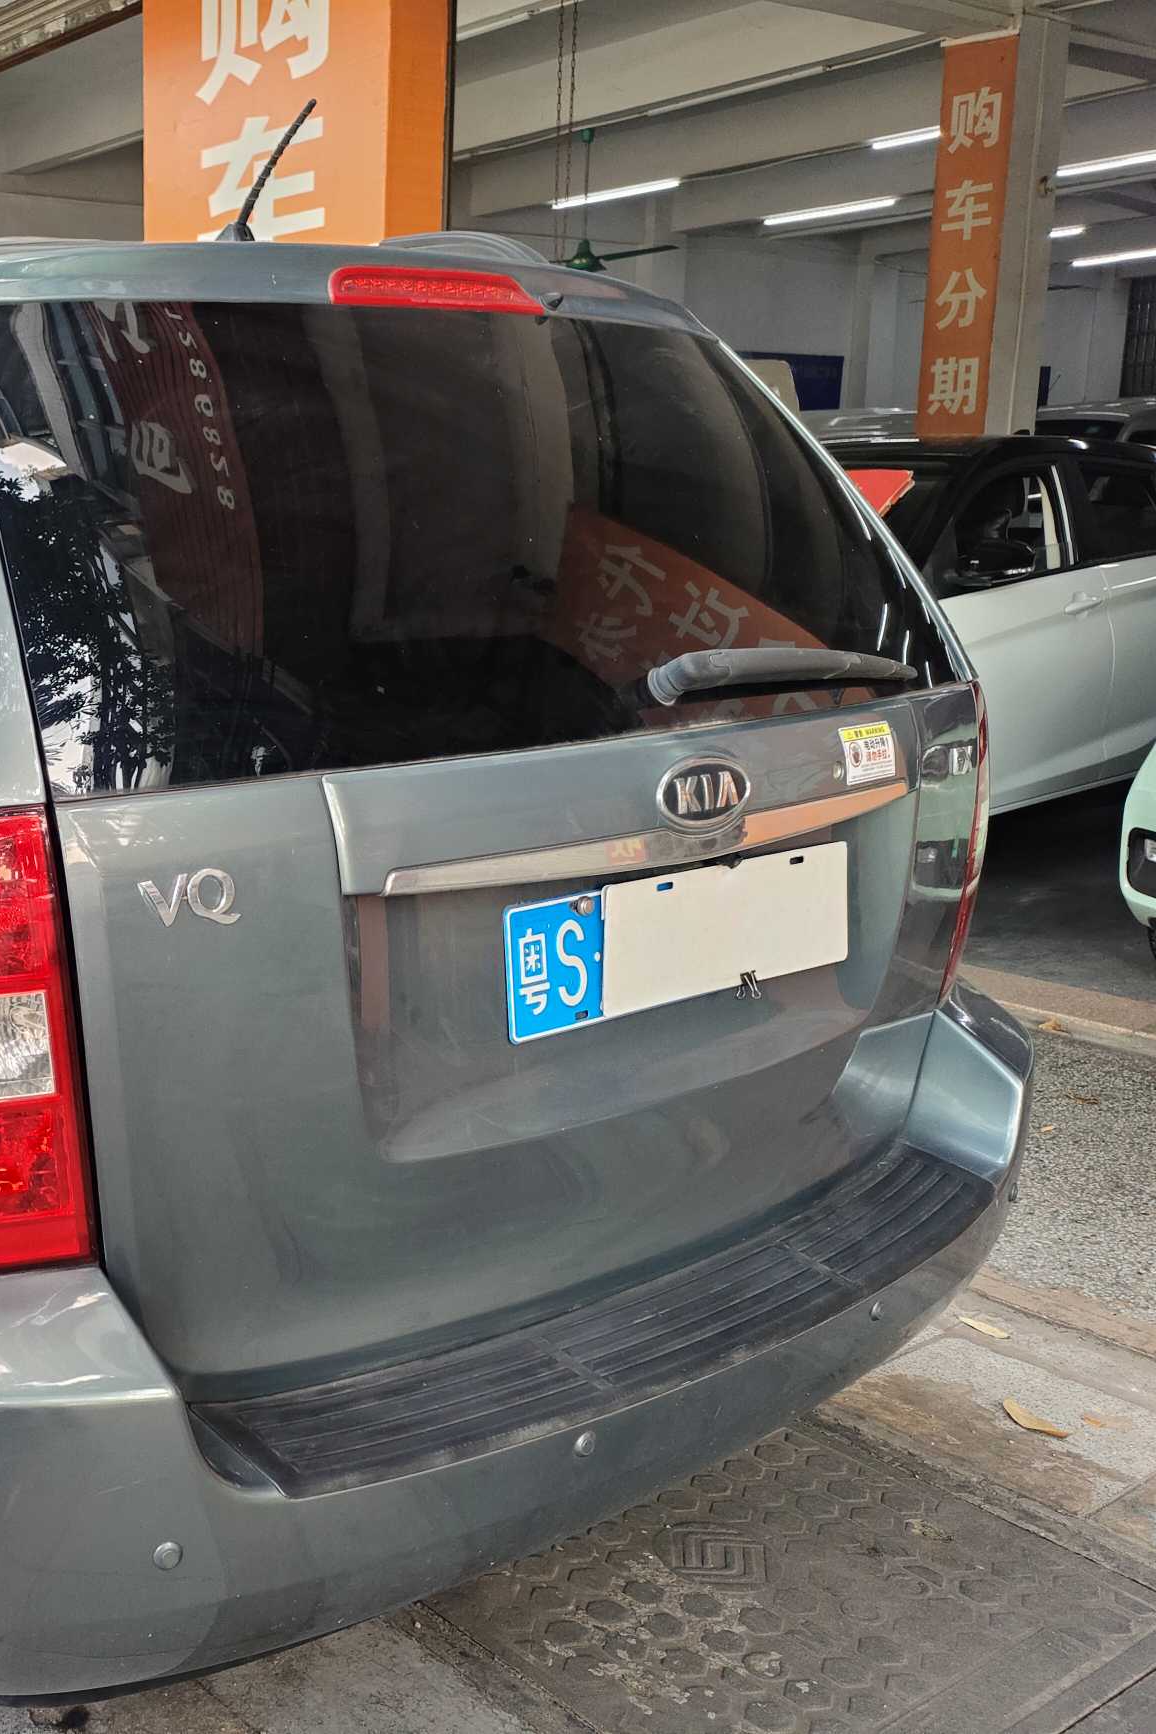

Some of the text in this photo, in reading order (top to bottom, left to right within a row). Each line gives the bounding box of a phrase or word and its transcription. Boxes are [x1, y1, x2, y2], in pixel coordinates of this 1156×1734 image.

[927, 87, 1002, 416] 购车分期
[673, 770, 739, 815] KIA
[137, 868, 242, 927] VQ
